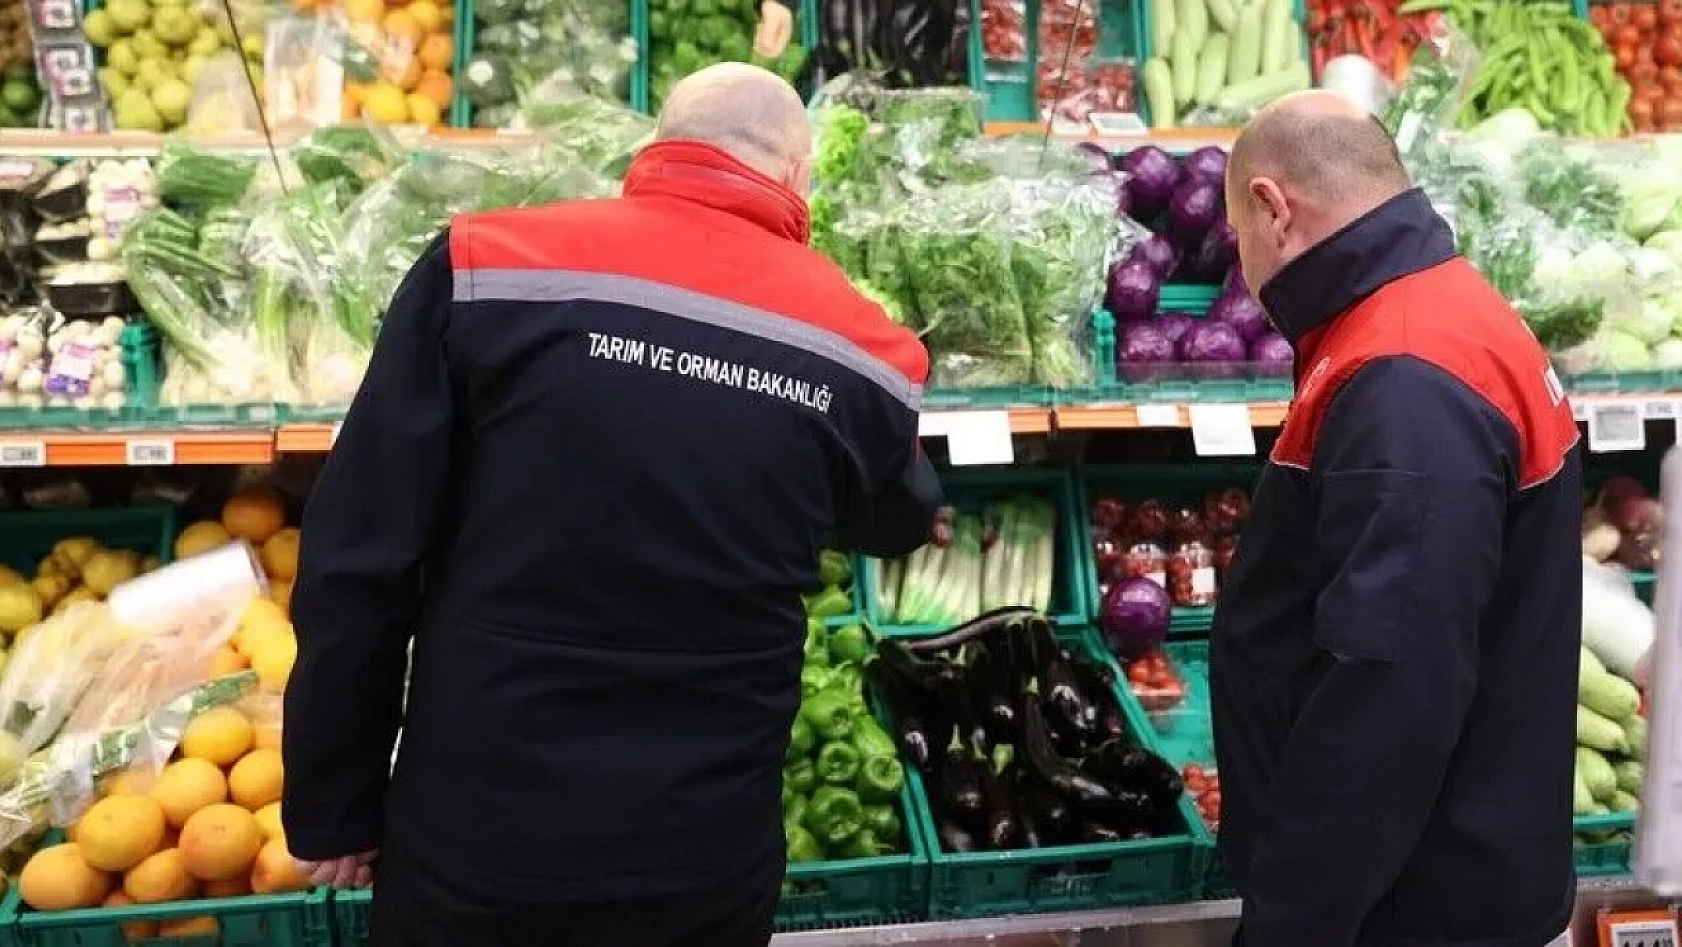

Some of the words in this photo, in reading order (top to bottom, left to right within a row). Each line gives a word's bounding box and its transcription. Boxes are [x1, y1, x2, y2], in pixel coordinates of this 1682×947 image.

[588, 332, 645, 366] TARIM
[649, 344, 675, 371] VE
[677, 351, 744, 389] ORMAN
[746, 367, 833, 414] BAKANLIĞI
